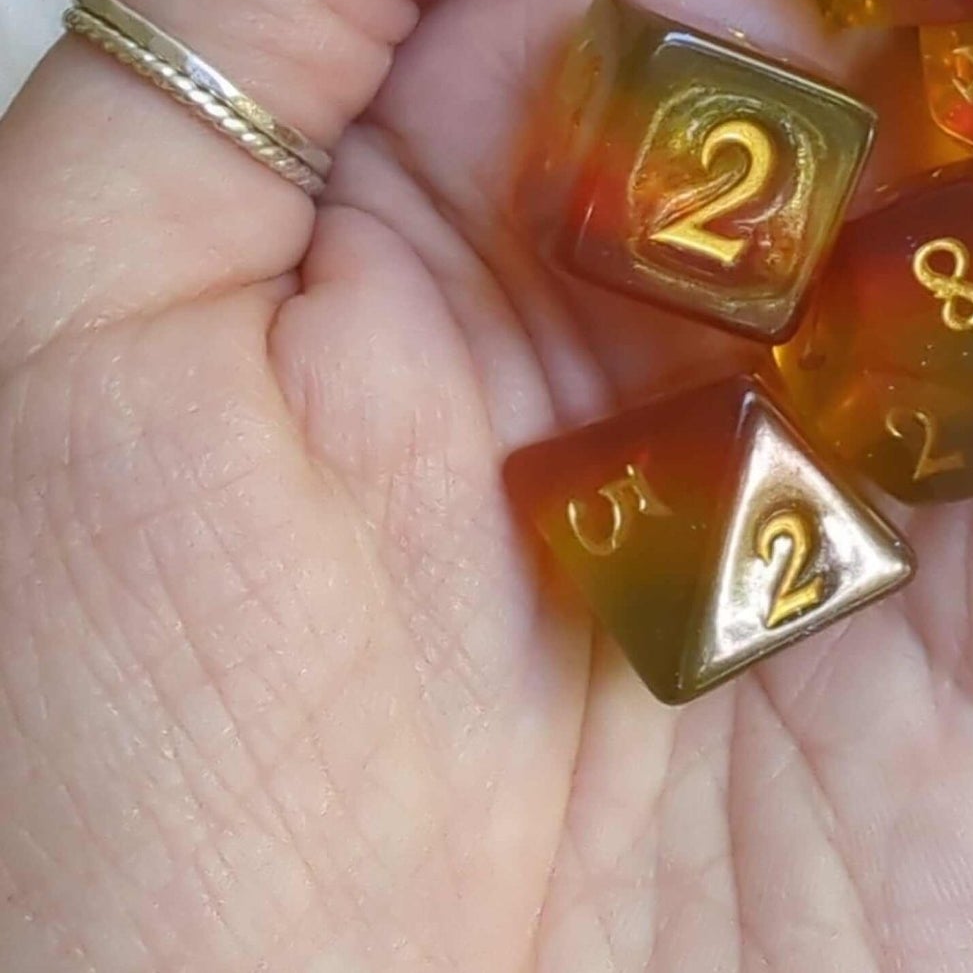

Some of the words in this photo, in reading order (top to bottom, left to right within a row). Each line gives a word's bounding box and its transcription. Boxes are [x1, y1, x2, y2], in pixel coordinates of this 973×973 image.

[648, 119, 774, 267] 2
[885, 409, 967, 482] 2
[565, 462, 675, 557] 5
[755, 510, 825, 630] 2
